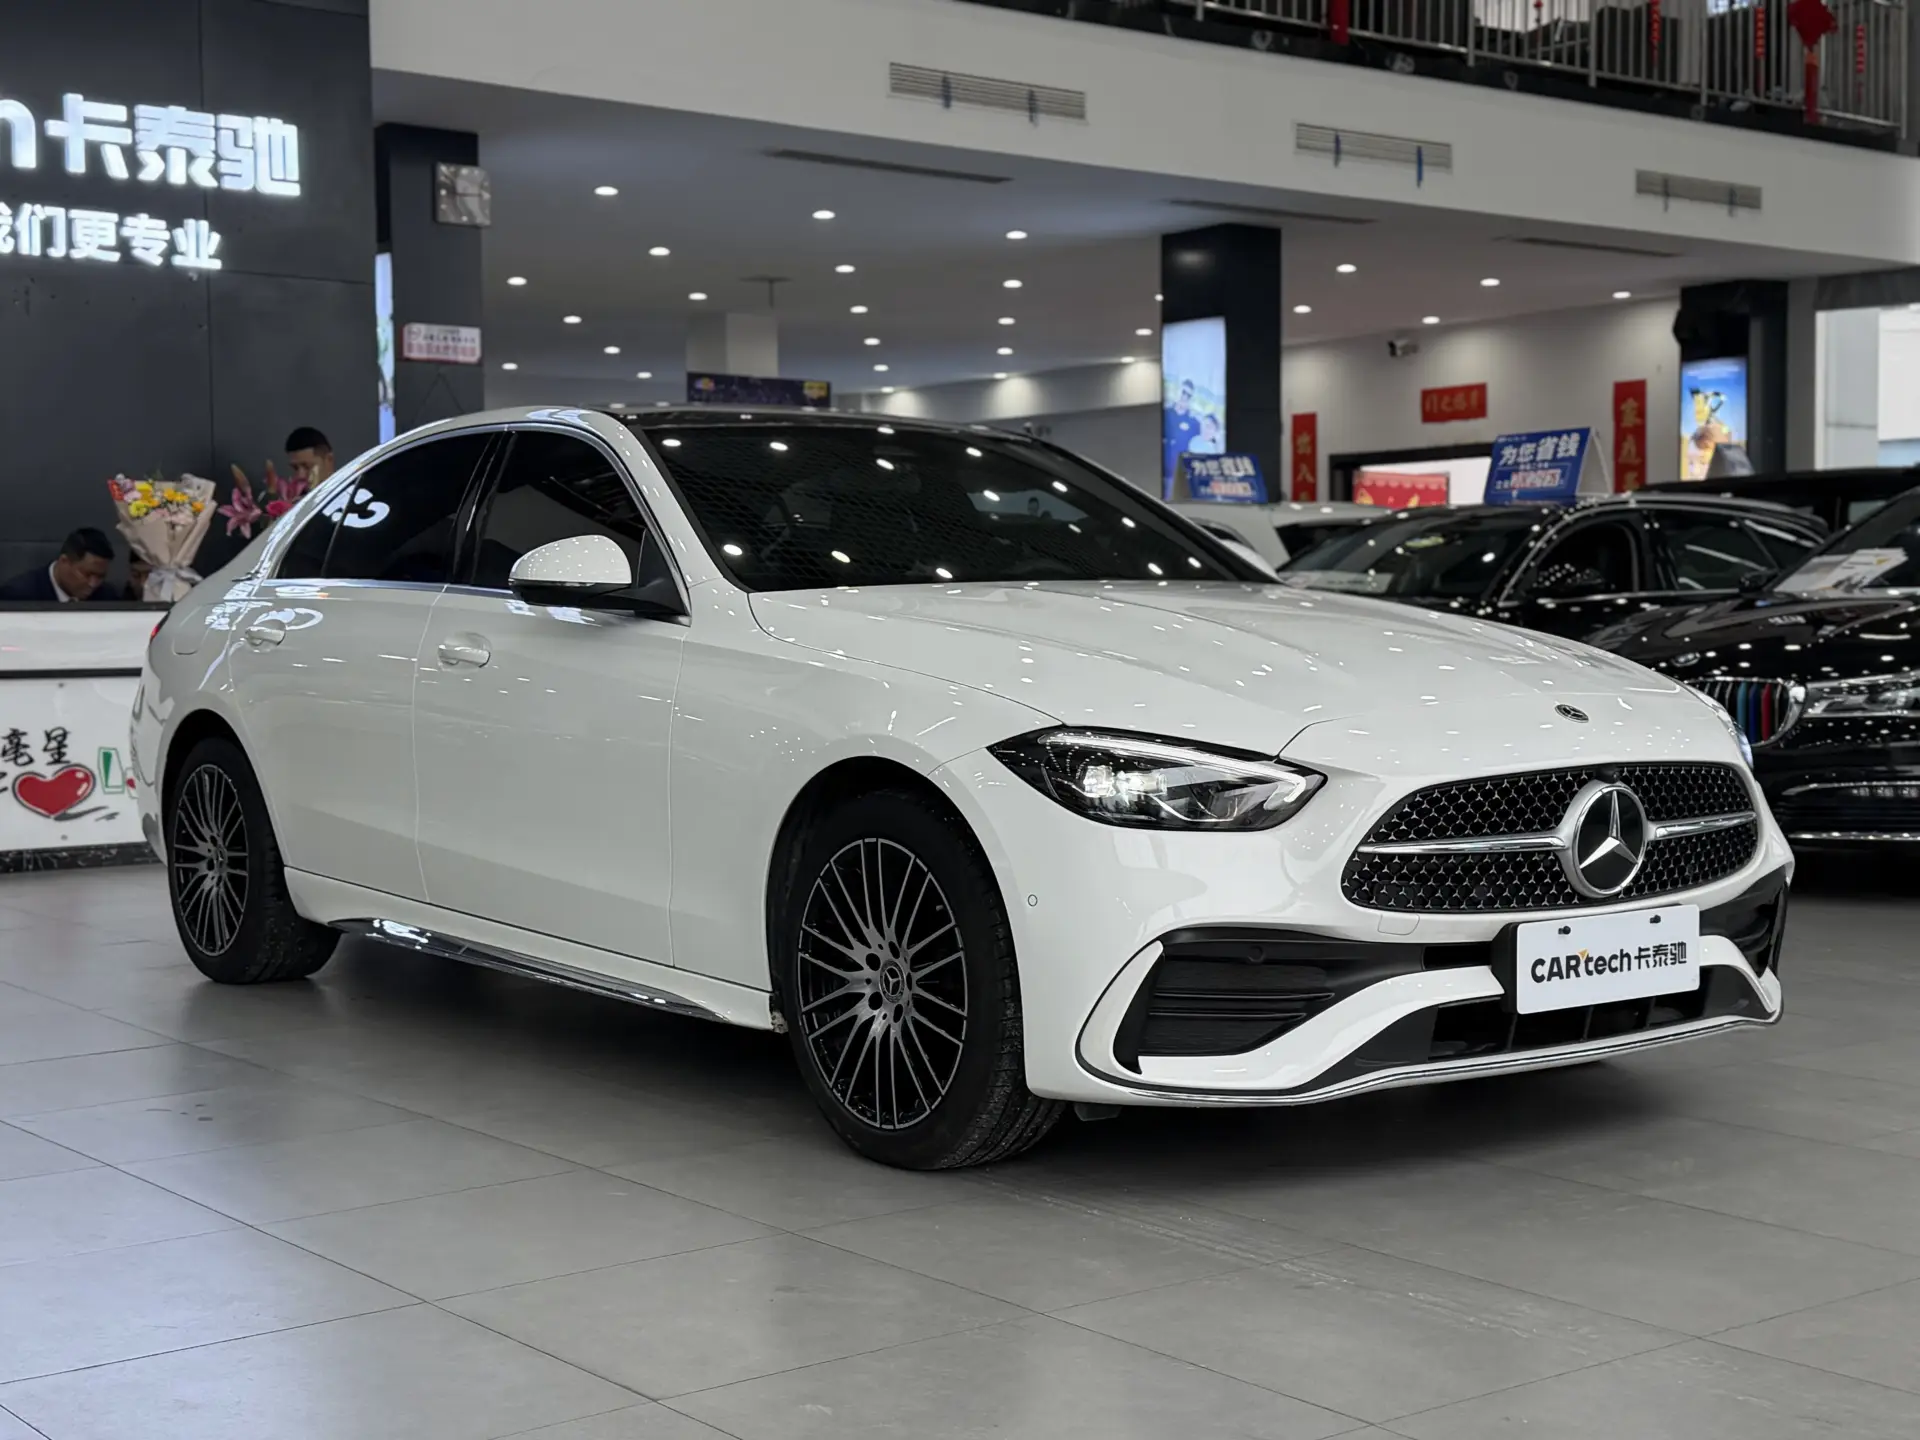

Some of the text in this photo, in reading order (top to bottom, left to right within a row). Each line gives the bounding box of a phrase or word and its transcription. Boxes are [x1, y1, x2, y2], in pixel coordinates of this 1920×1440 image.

[44, 92, 301, 197] 卡泰驰
[0, 202, 222, 270] 们更专业
[1499, 432, 1580, 466] 为您省钱
